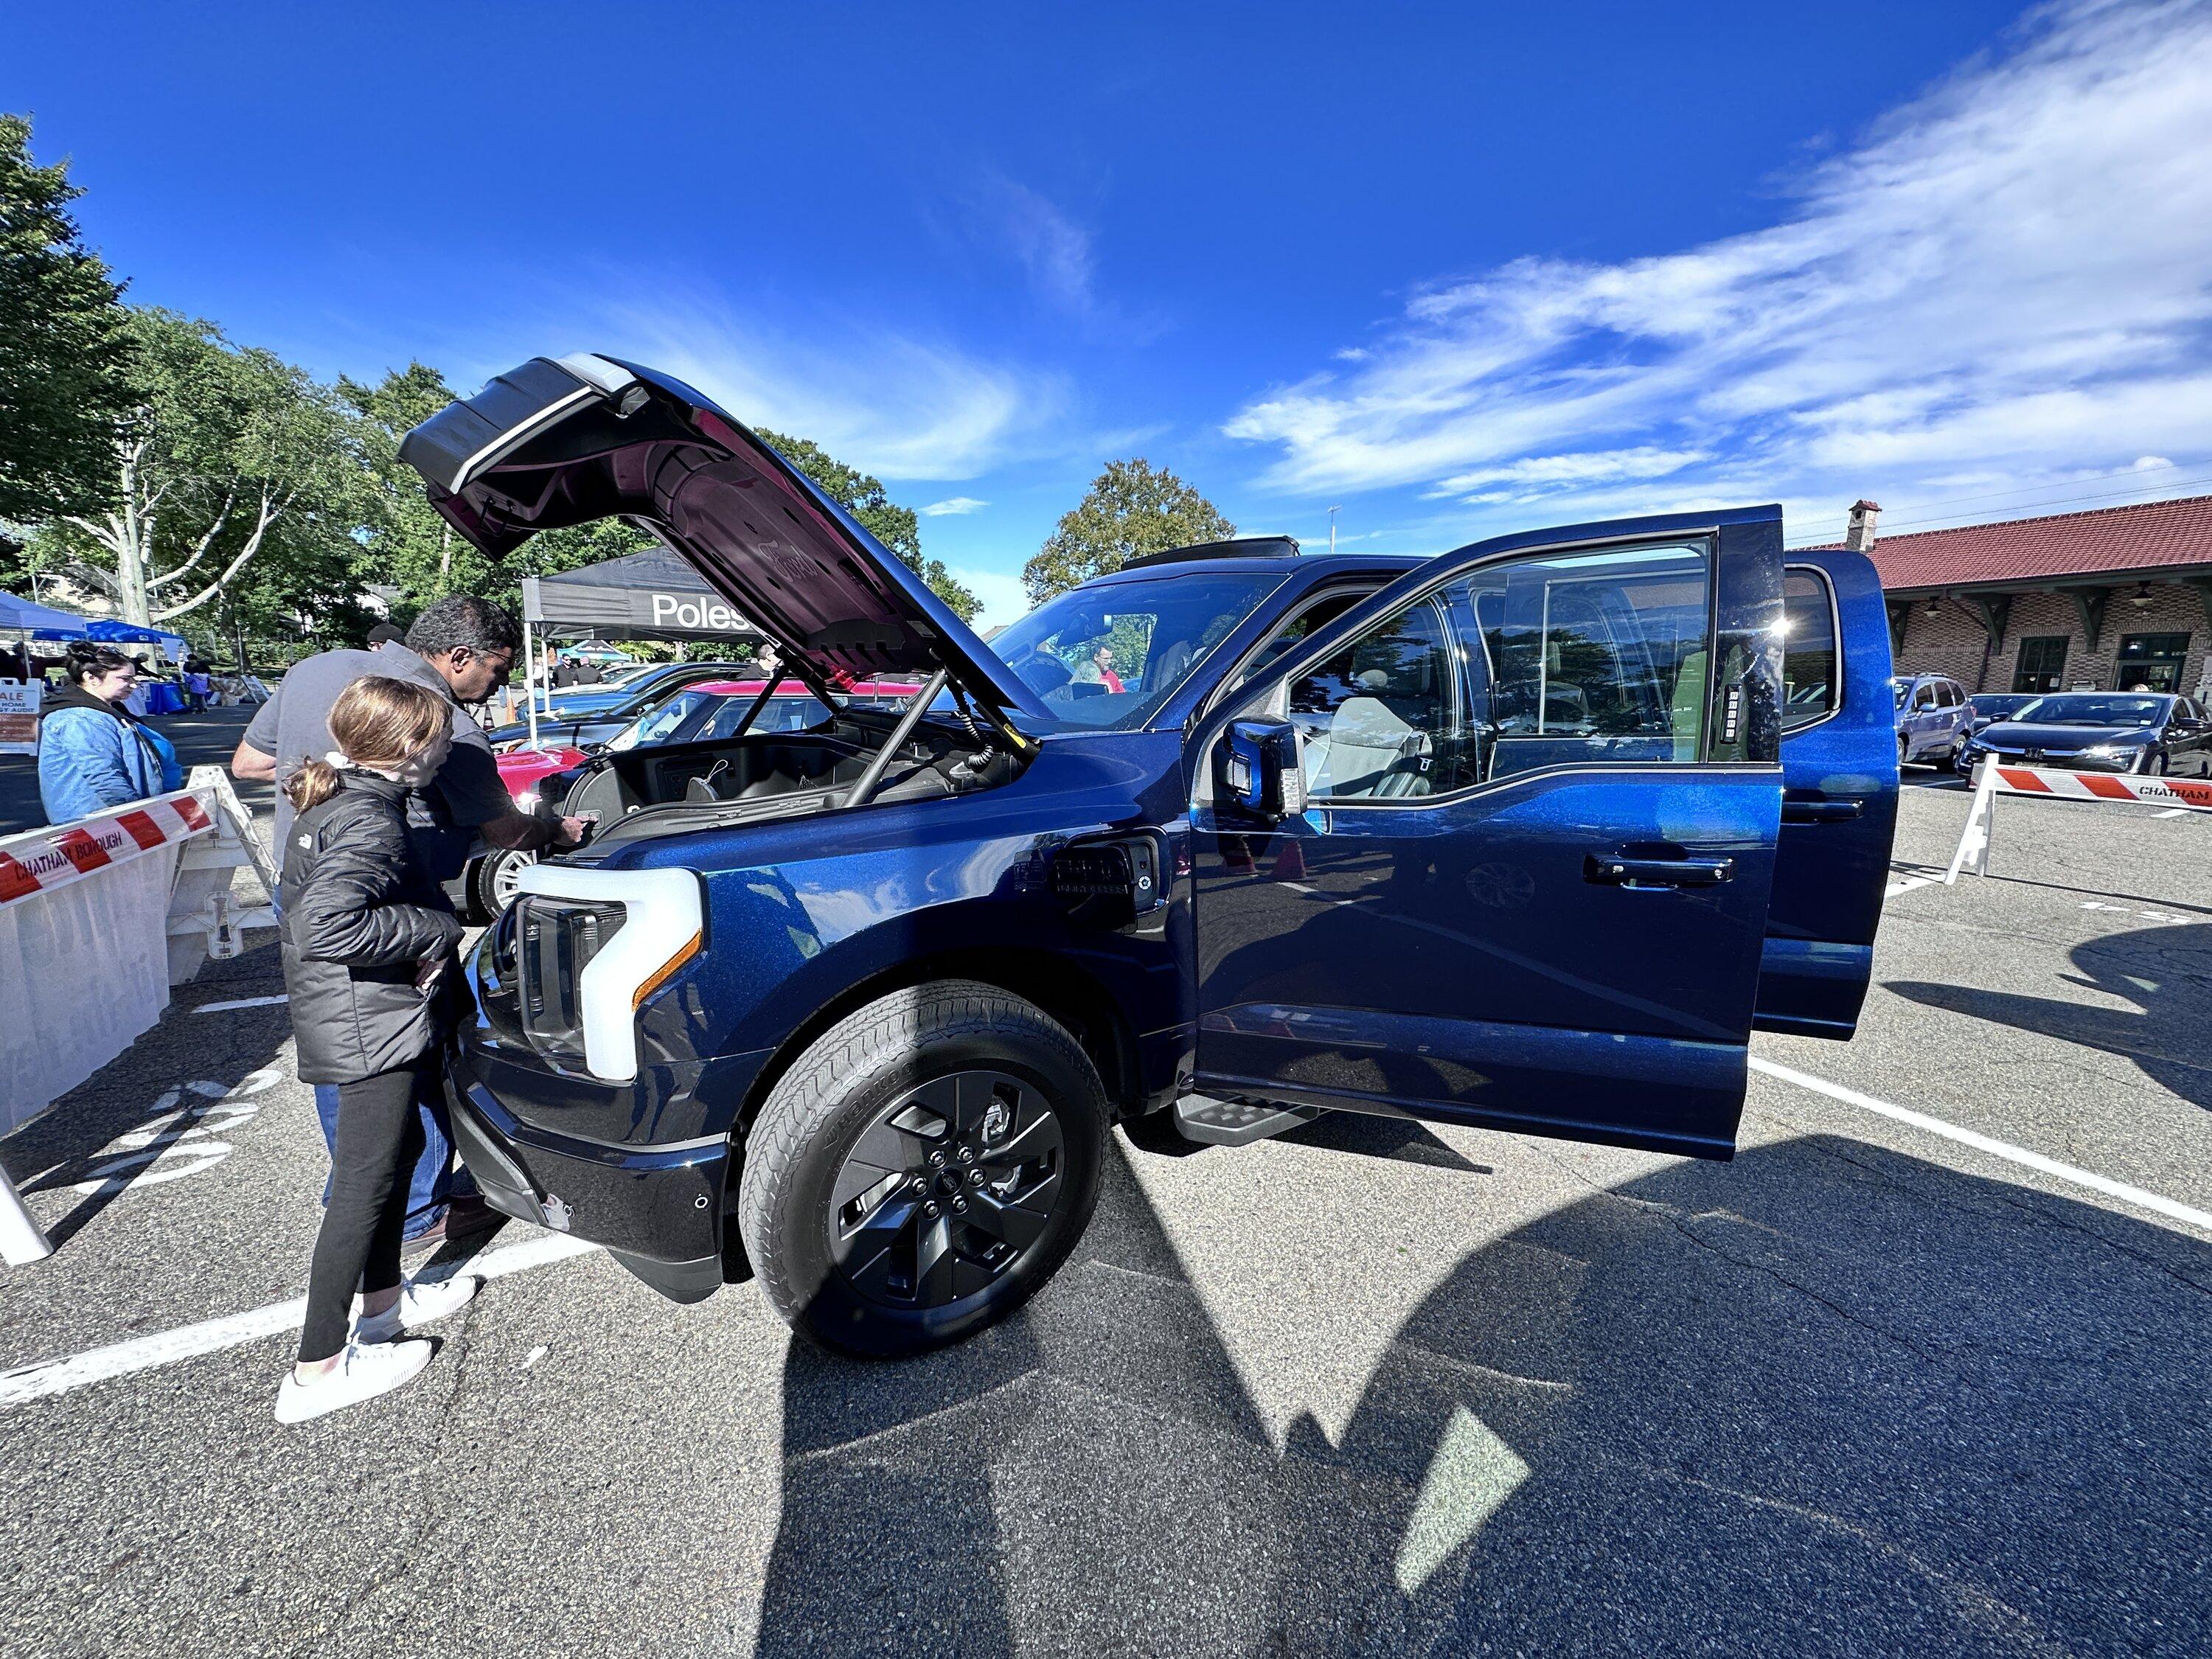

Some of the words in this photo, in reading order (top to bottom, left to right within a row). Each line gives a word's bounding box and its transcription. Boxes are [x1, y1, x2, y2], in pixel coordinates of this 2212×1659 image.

[758, 539, 818, 582] Ford
[653, 594, 750, 630] Poles
[2139, 787, 2209, 799] CHATHAM
[14, 849, 72, 880] CHATHAM
[74, 832, 122, 860] BOROUGH
